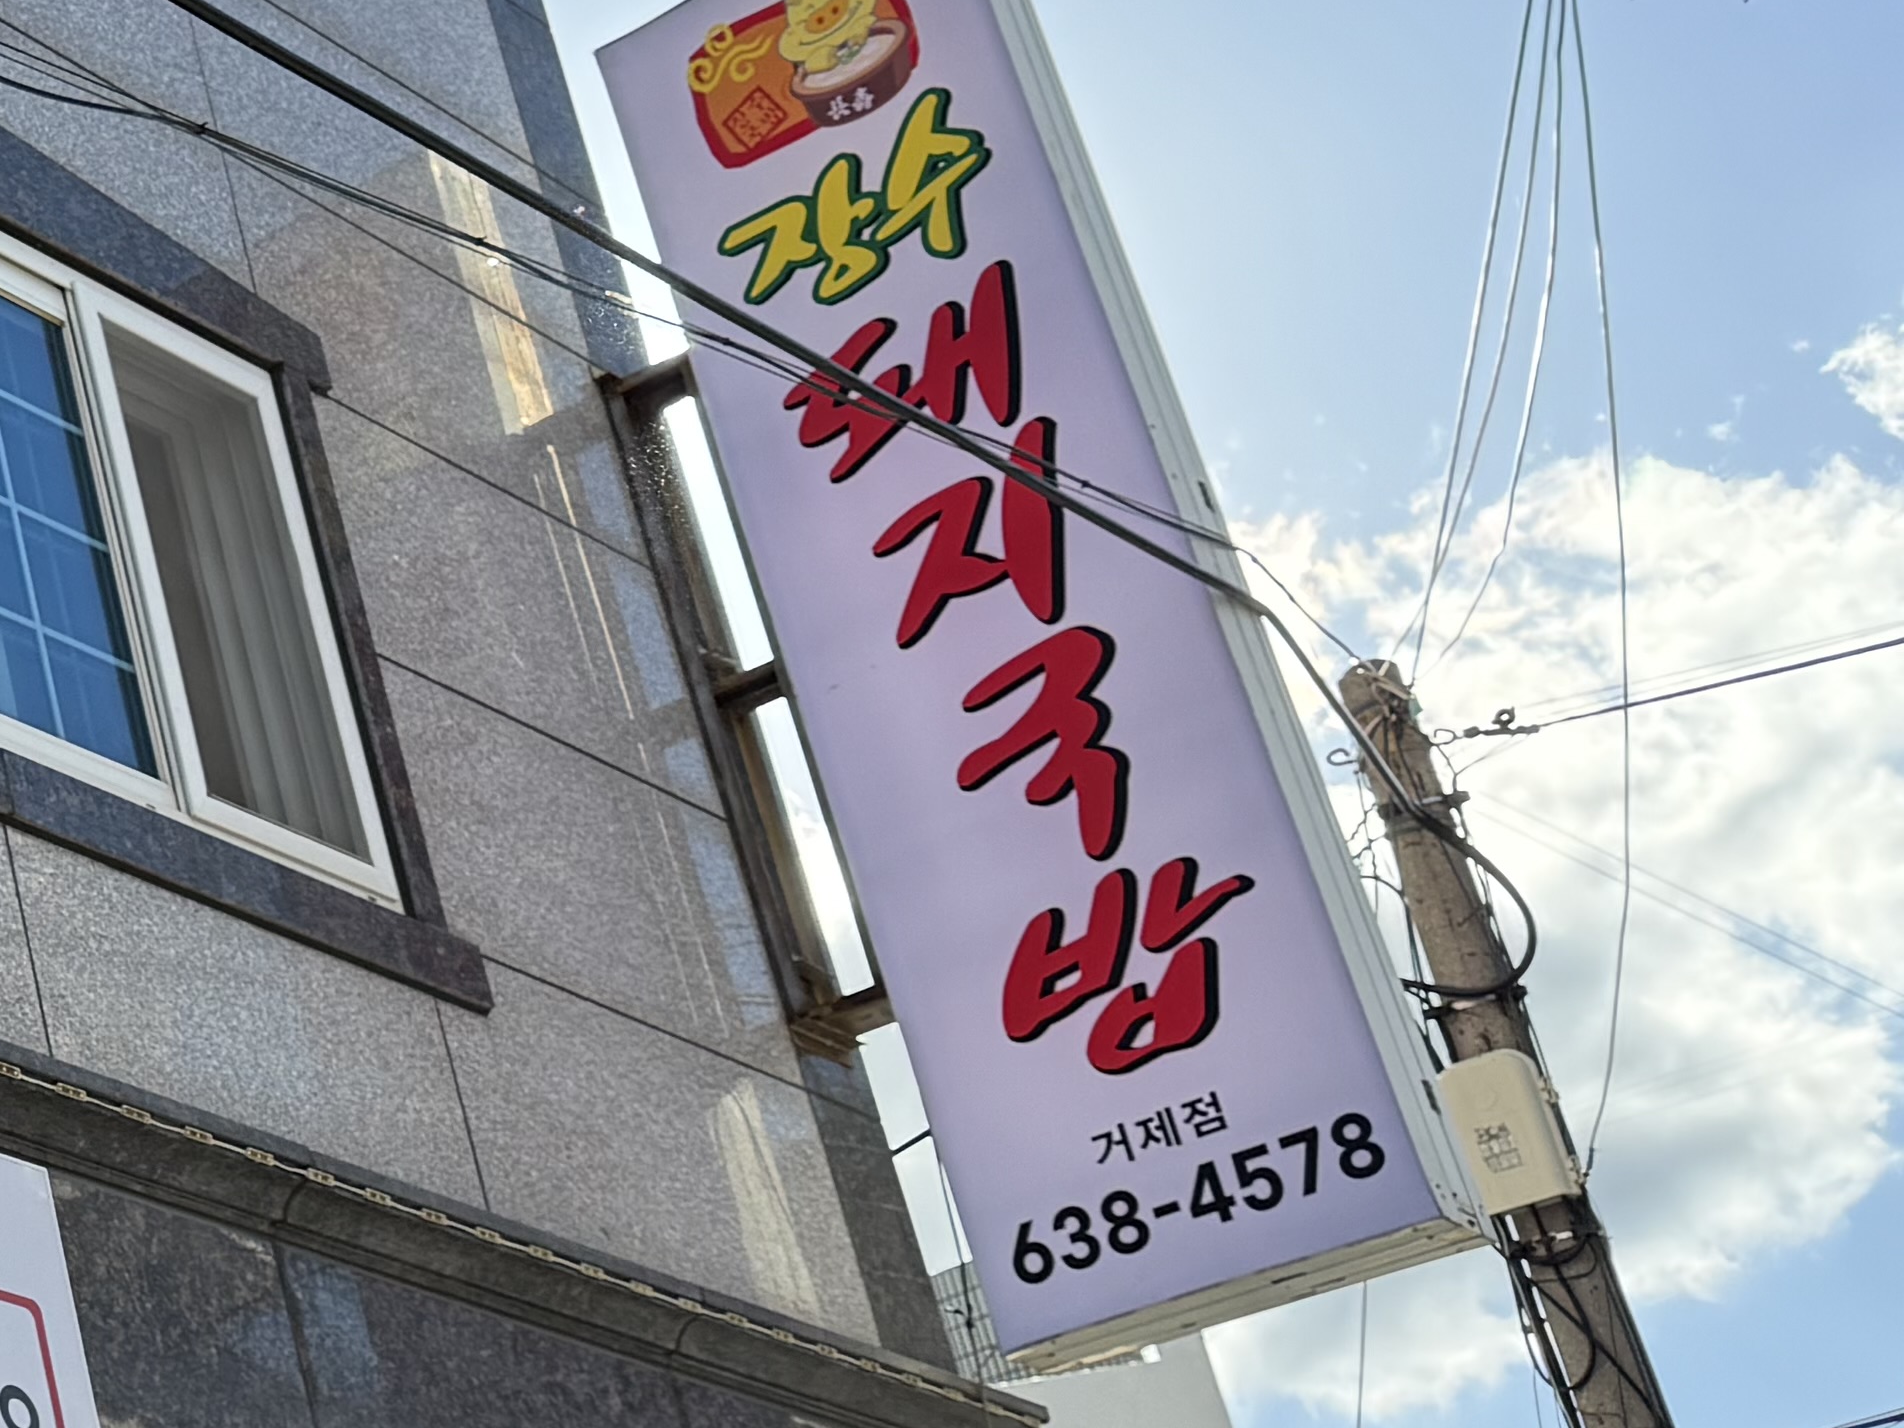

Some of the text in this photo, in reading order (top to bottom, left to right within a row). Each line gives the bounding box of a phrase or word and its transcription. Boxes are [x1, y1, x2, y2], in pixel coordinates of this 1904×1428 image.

[718, 86, 992, 305] 장수
[1011, 1112, 1387, 1286] 638-4578
[1090, 1090, 1230, 1170] 거제점
